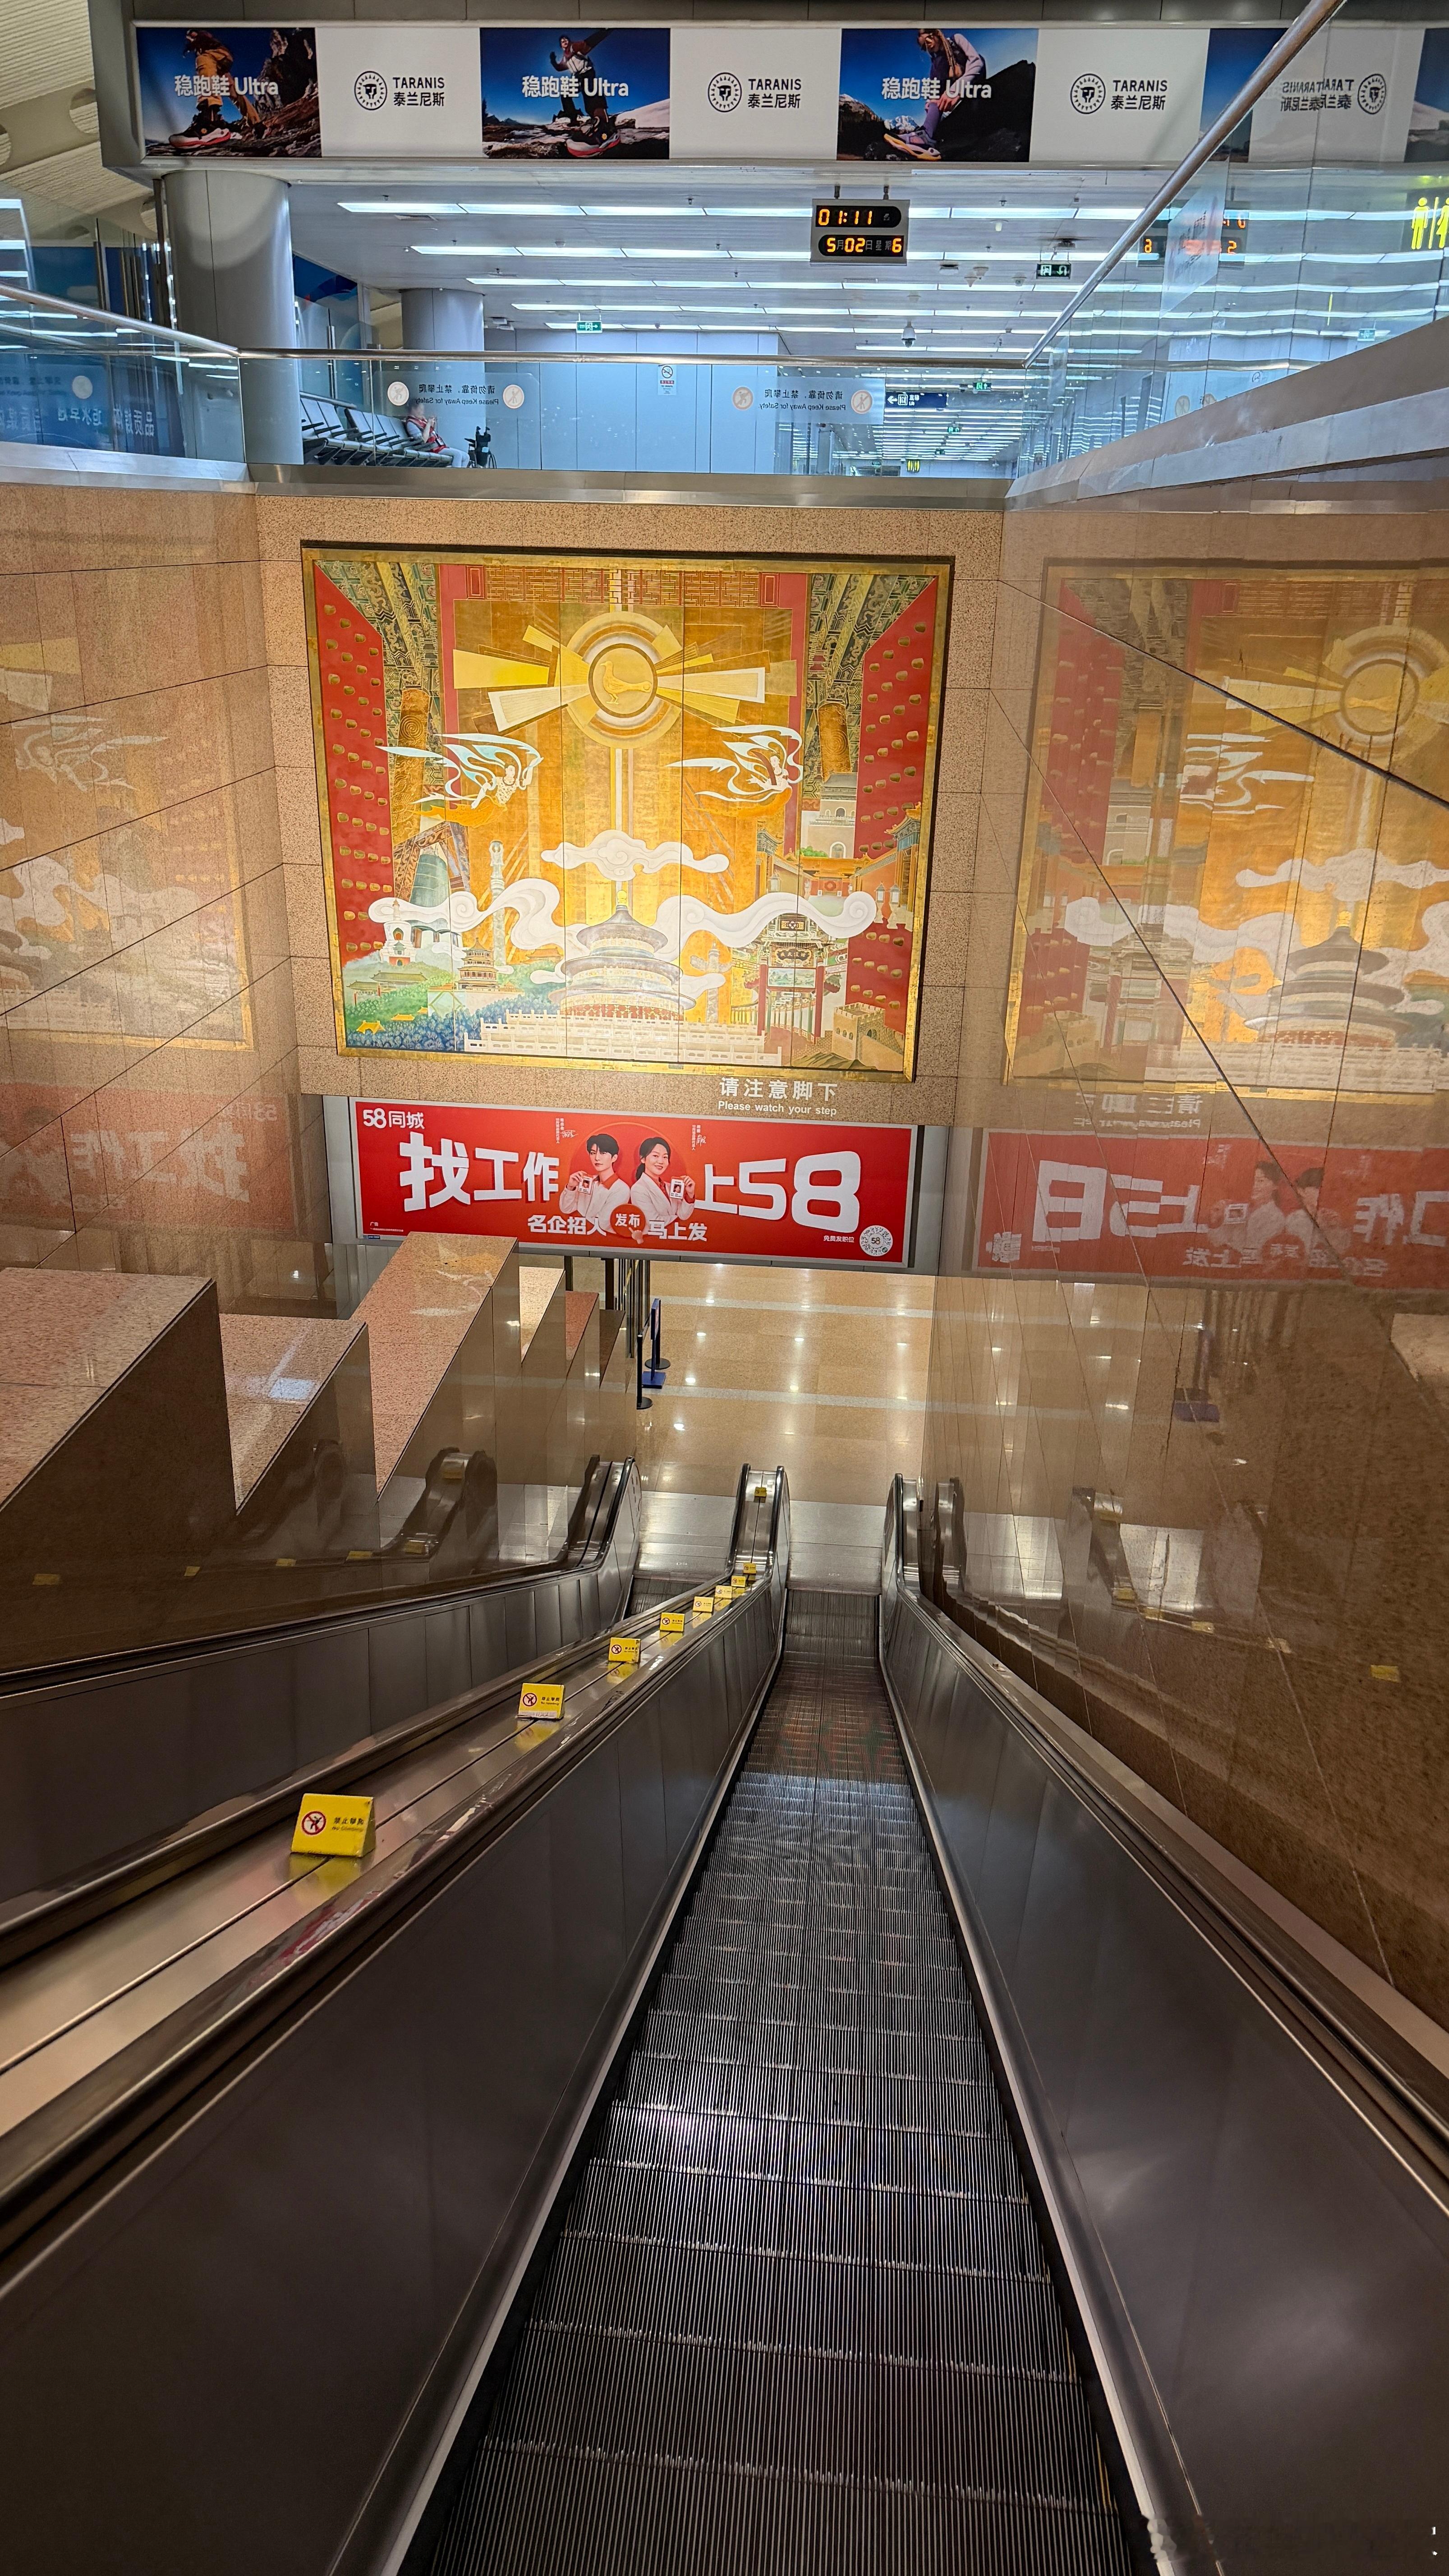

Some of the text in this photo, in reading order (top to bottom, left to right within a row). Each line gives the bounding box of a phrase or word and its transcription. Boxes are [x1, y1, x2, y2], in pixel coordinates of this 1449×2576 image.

[175, 75, 279, 98] 稳跑鞋 Ultra
[392, 77, 445, 89] TARANIS
[522, 75, 629, 98] 稳跑鞋 Ultra
[748, 78, 802, 91] TARANIS
[881, 77, 992, 100] 稳跑鞋 Ultra
[1113, 80, 1168, 92] TARANIS
[393, 92, 445, 107] 泰兰尼斯
[748, 93, 801, 109] 泰兰尼斯
[1111, 95, 1165, 110] 泰兰尼斯
[818, 209, 872, 225] 01:11
[719, 1077, 838, 1101] 请注意脚下
[718, 1100, 837, 1117] Please watch your step
[363, 1108, 425, 1129] 58同城
[399, 1131, 861, 1233] 找工作 上58
[527, 1213, 708, 1242] 名企招人 发布 马上发
[871, 1237, 881, 1245] 58
